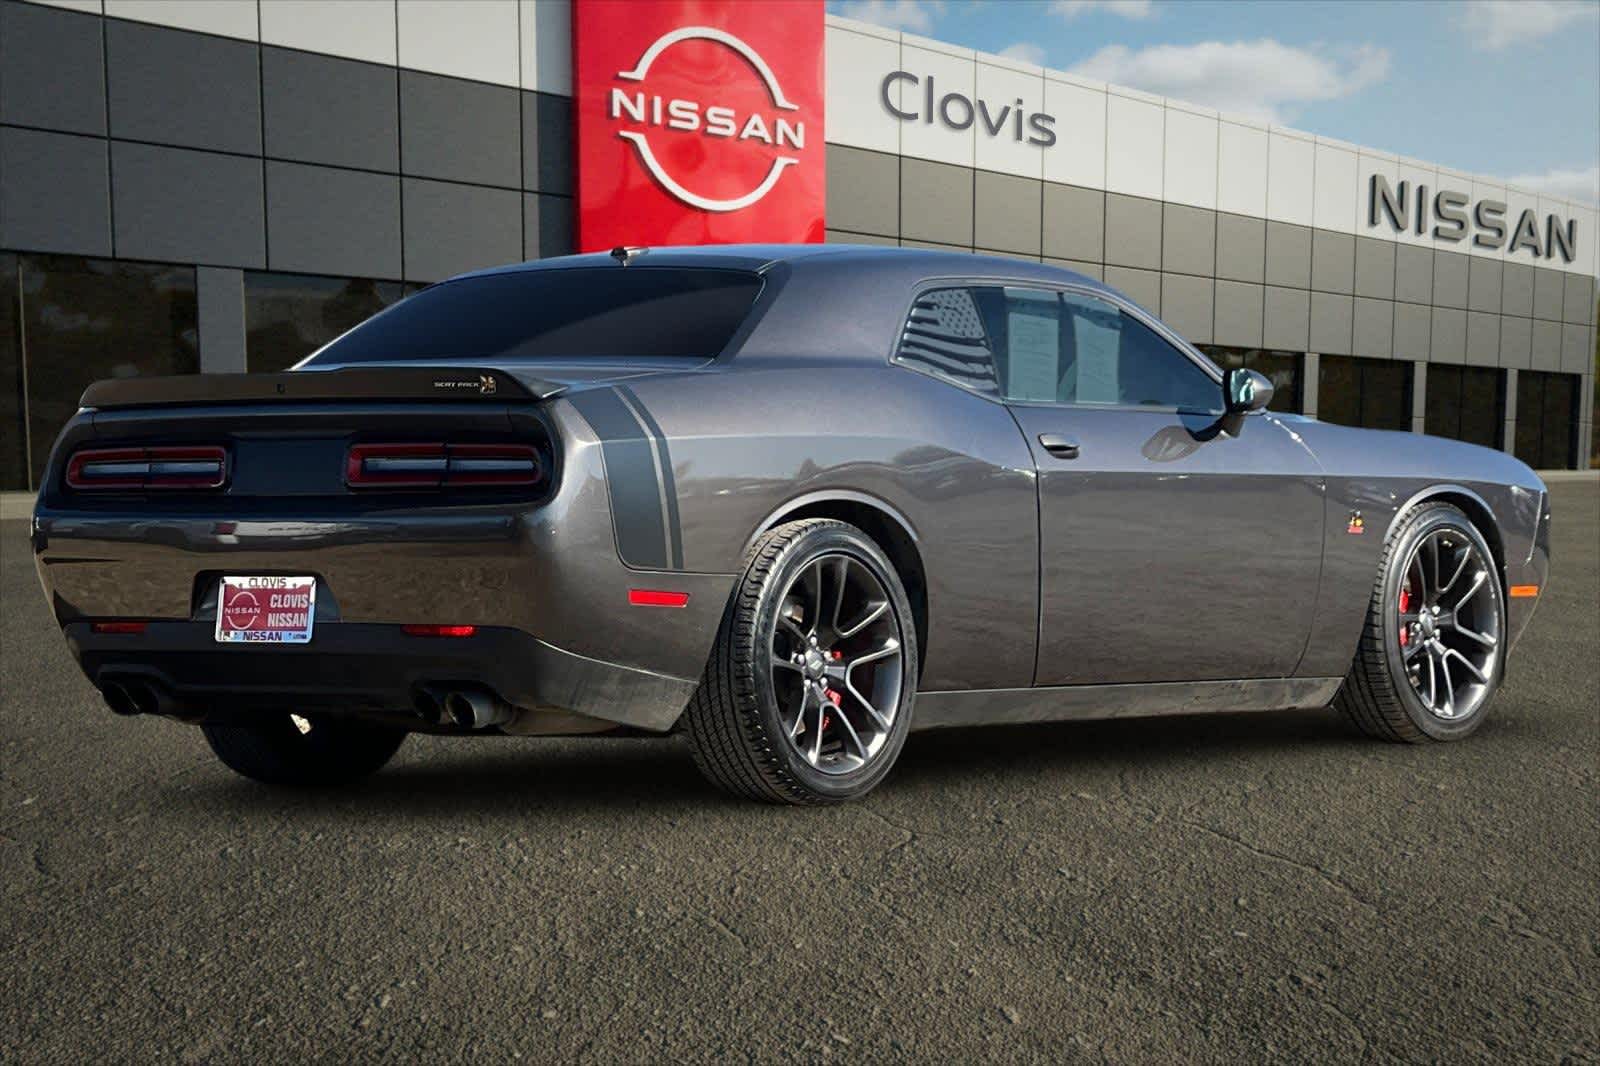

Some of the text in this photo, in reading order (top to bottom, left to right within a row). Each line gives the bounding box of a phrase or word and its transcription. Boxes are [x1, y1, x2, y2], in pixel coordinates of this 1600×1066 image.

[880, 70, 1057, 147] Clovis
[611, 87, 805, 149] NISSAN
[1369, 174, 1577, 263] NISSAN
[248, 577, 287, 588] CLOVIS
[269, 594, 309, 608] CLOVIS
[267, 613, 308, 628] NISSAN
[242, 631, 282, 641] NISSAN
